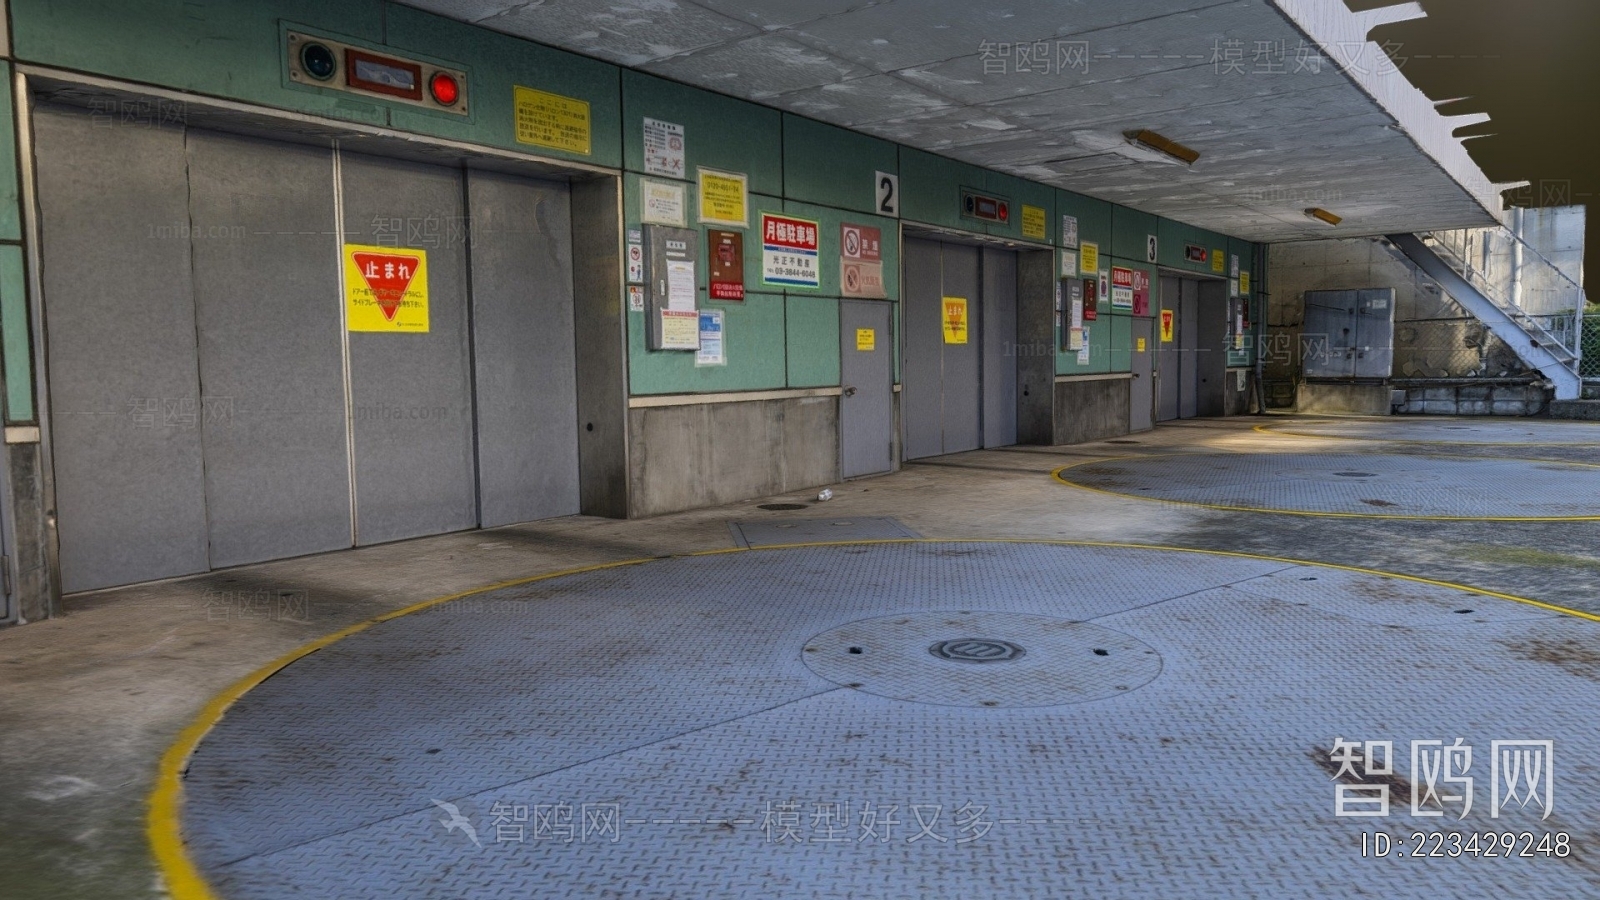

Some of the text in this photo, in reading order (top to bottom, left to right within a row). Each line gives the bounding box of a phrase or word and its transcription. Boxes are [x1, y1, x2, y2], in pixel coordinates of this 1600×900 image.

[881, 177, 893, 213] 2
[1149, 237, 1155, 261] 3
[365, 261, 410, 279] 止まれ
